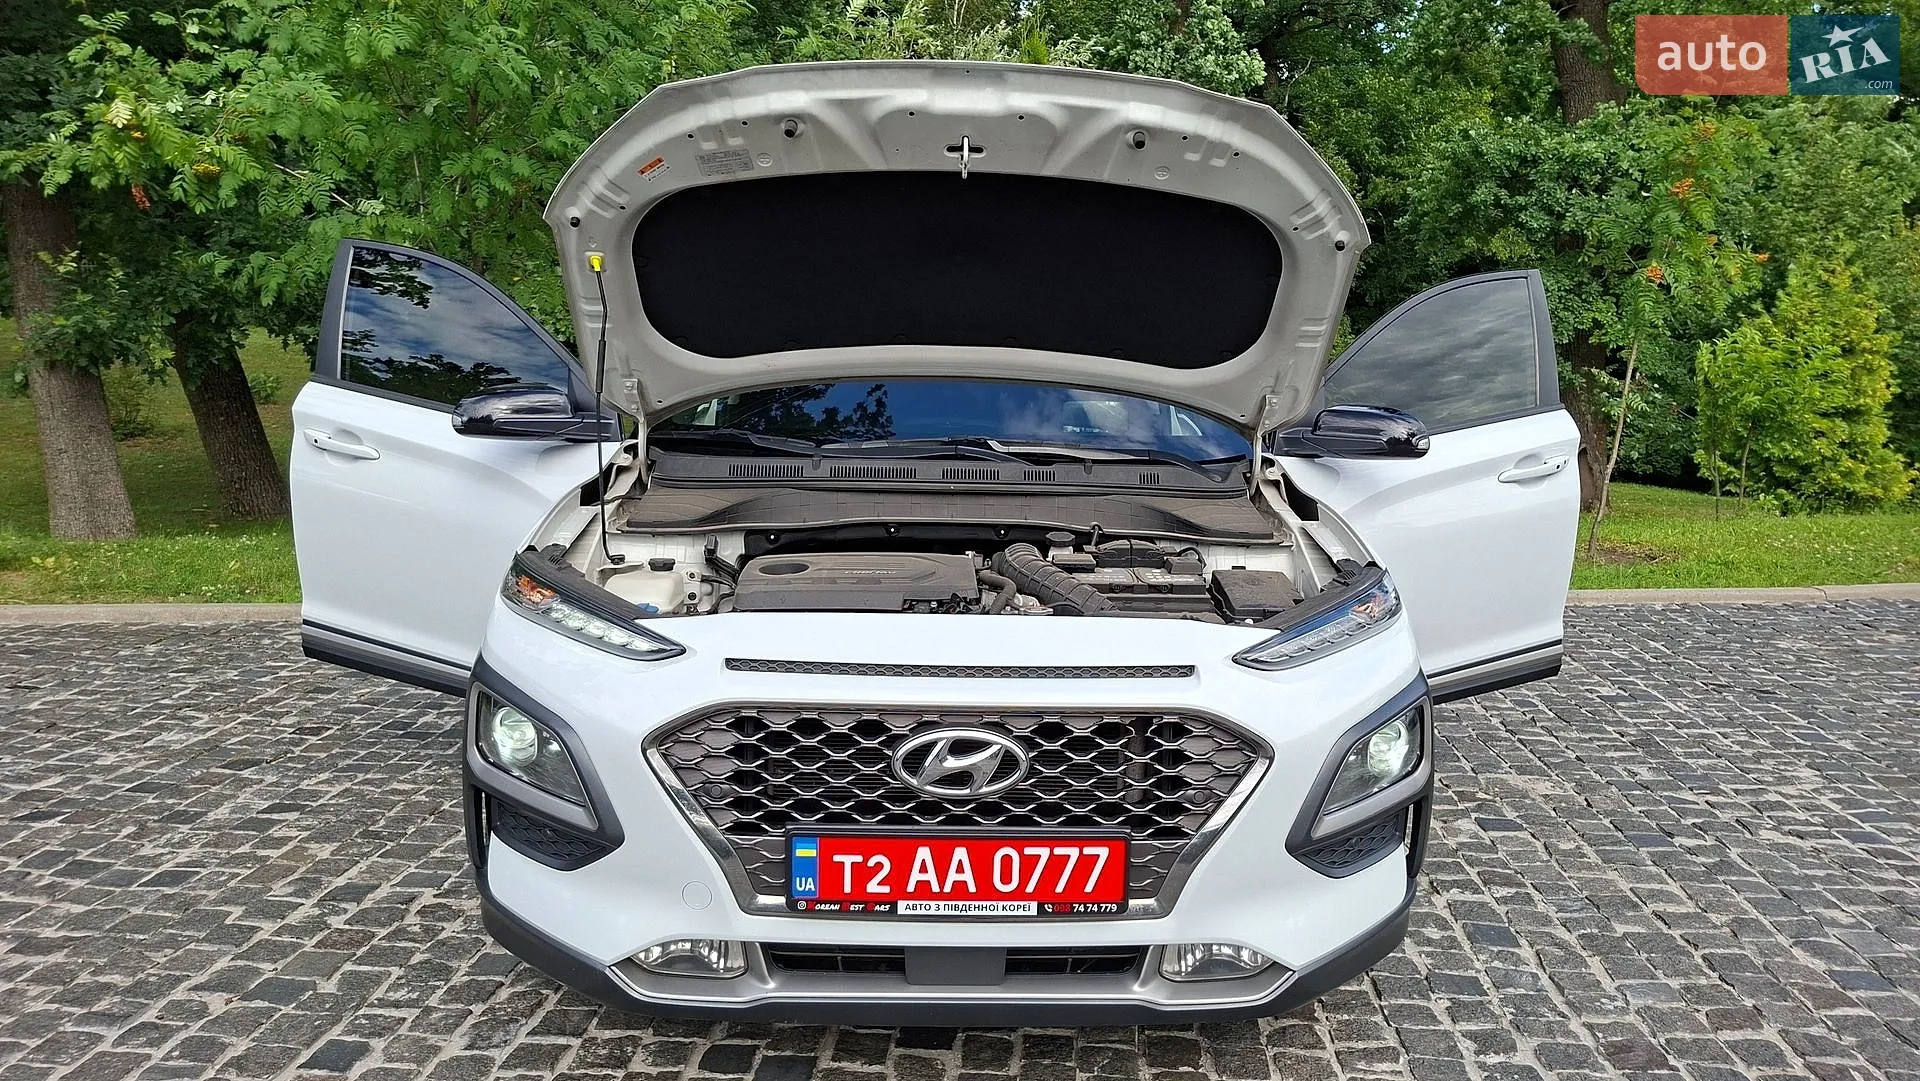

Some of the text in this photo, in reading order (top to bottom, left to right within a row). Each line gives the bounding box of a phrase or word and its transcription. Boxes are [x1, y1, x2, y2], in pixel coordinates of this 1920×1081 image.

[832, 846, 1110, 893] T2 AA 0777
[796, 877, 815, 891] UA
[904, 903, 931, 911] АВТО
[943, 902, 999, 913] ПІВДЕННОЇ
[1002, 902, 1032, 912] КОРЕЇ
[1072, 903, 1085, 912] 74
[1086, 903, 1098, 912] 74
[1100, 903, 1118, 912] 779
